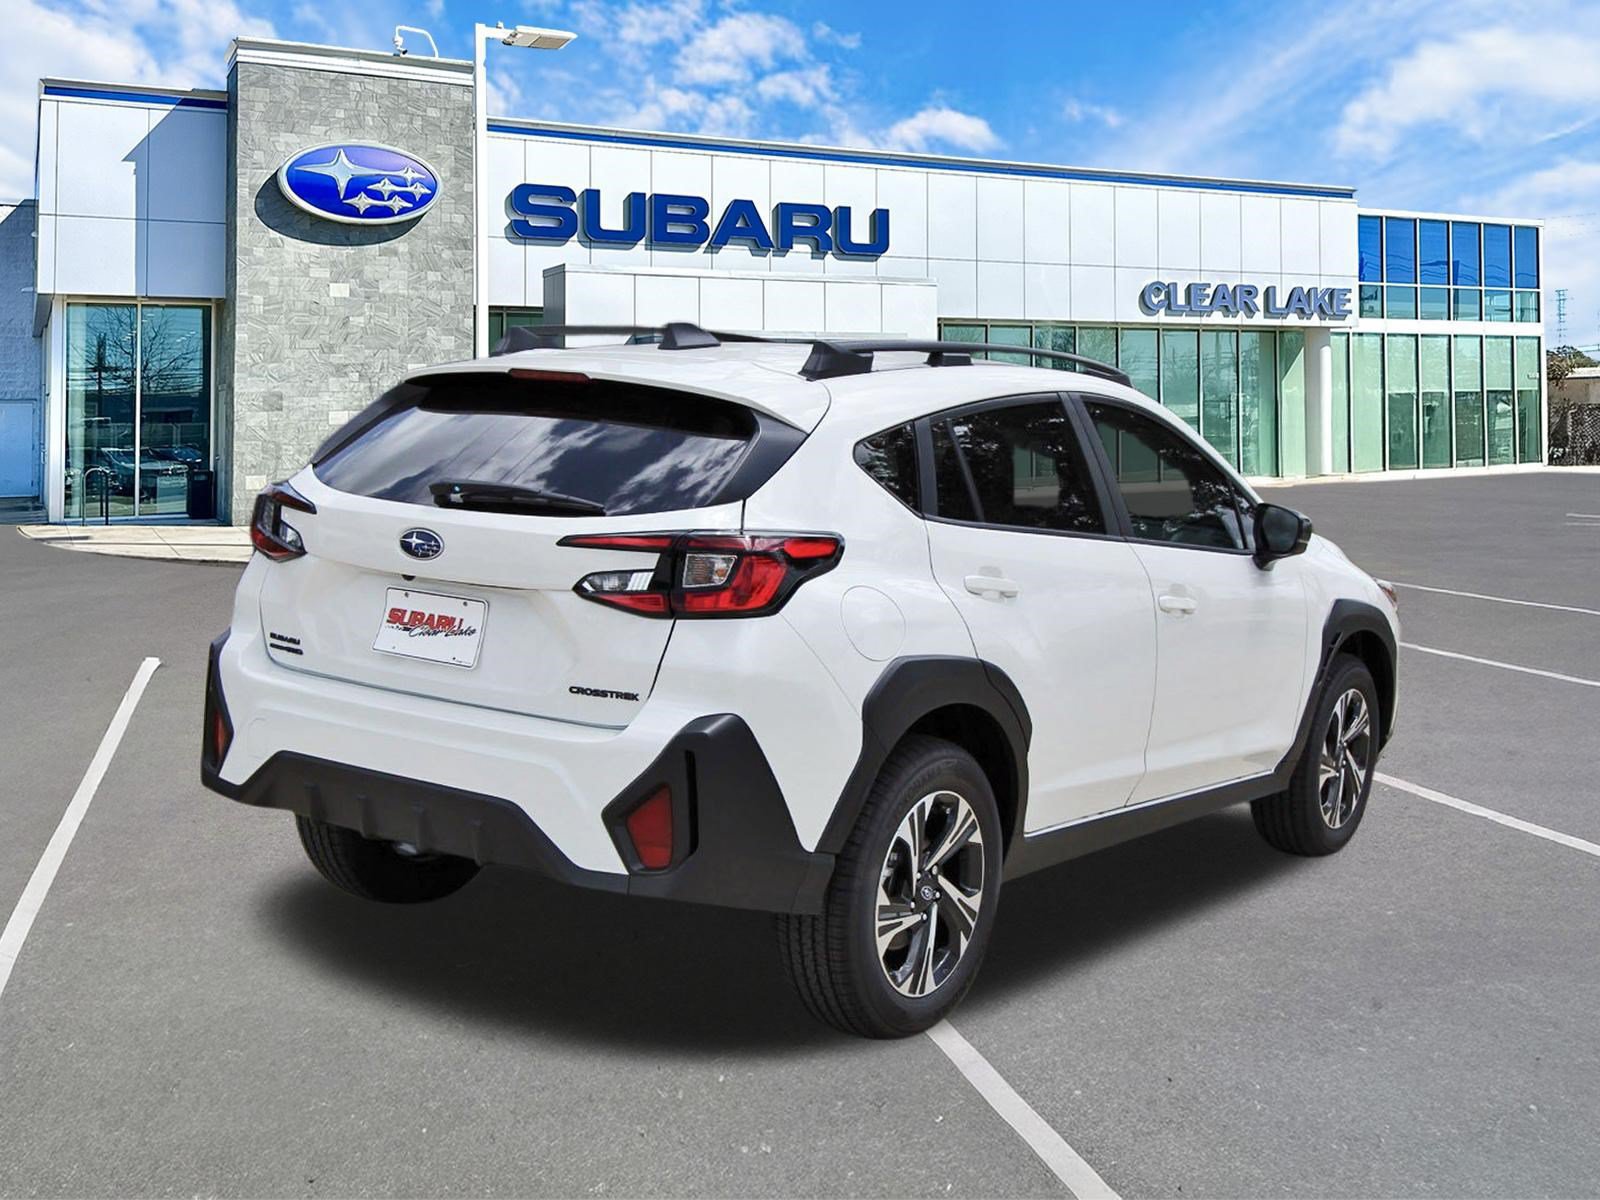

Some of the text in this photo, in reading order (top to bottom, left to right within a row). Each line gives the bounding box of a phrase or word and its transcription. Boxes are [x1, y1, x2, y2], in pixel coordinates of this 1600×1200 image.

[506, 183, 890, 258] SUBARU
[1140, 280, 1352, 320] CLEAR LAKE
[387, 607, 464, 631] SUBARU
[568, 686, 639, 701] CROSSTREK
